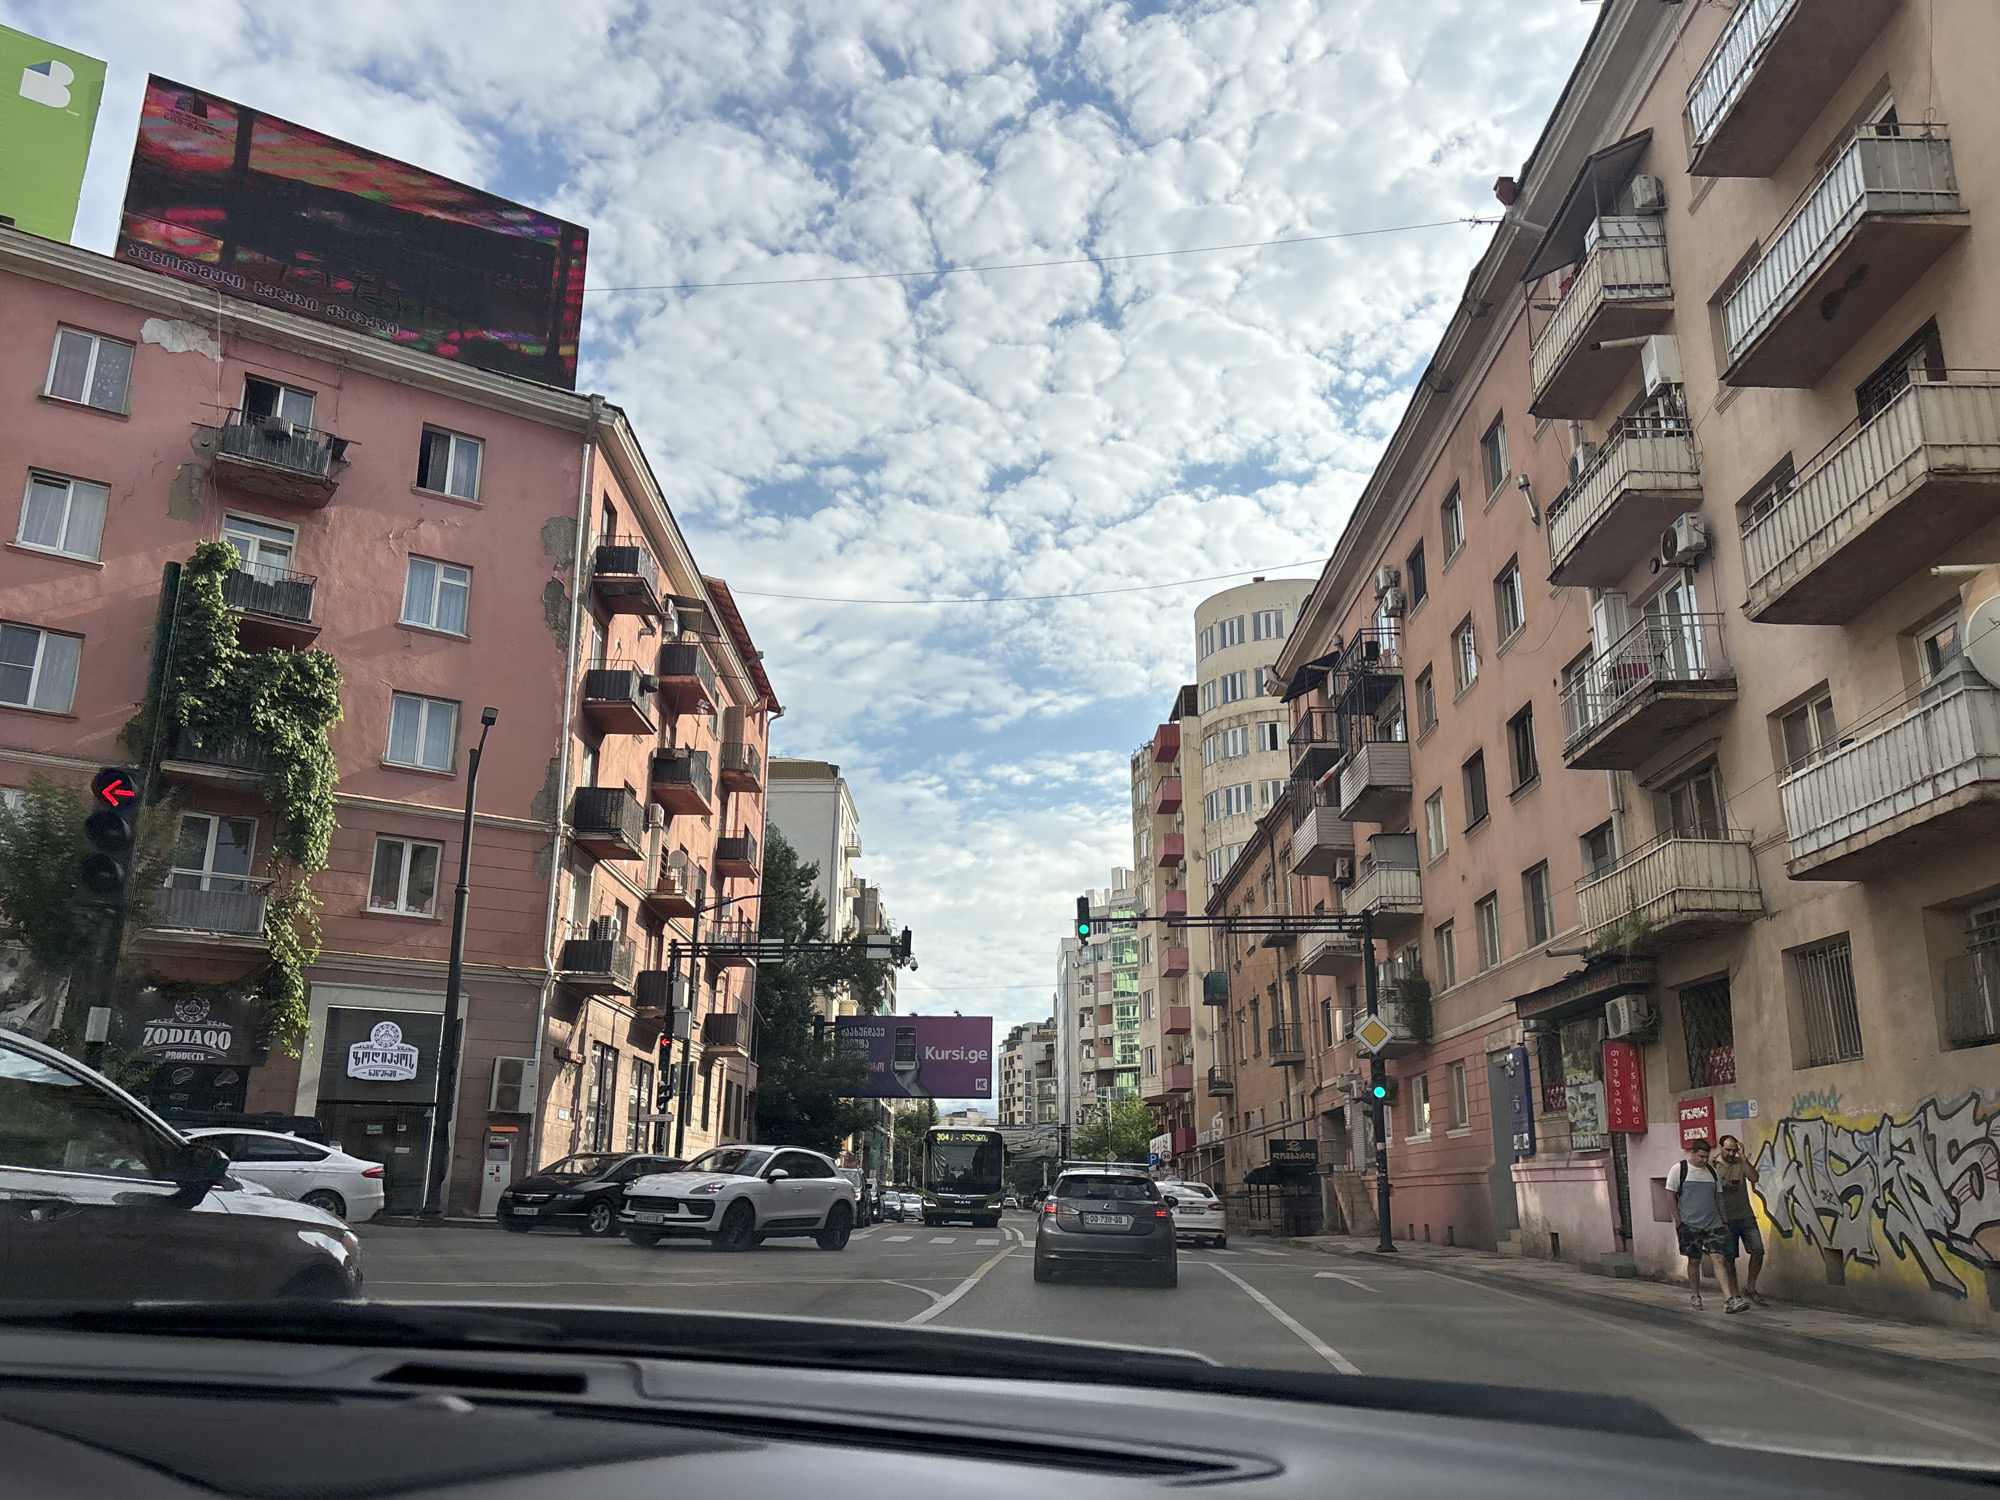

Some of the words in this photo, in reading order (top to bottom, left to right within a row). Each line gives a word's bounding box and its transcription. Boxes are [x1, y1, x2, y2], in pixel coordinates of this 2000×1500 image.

[254, 281, 319, 312] ხედები
[326, 303, 400, 335] ქალაქზე
[142, 1027, 232, 1050] ZODIAQO
[165, 1051, 205, 1061] PRODUCTS
[925, 1046, 988, 1064] Kursi.ge
[1611, 1050, 1622, 1124] თევზაობა
[1629, 1050, 1640, 1124] FISHING
[936, 1132, 949, 1141] 304
[1150, 1154, 1157, 1164] P
